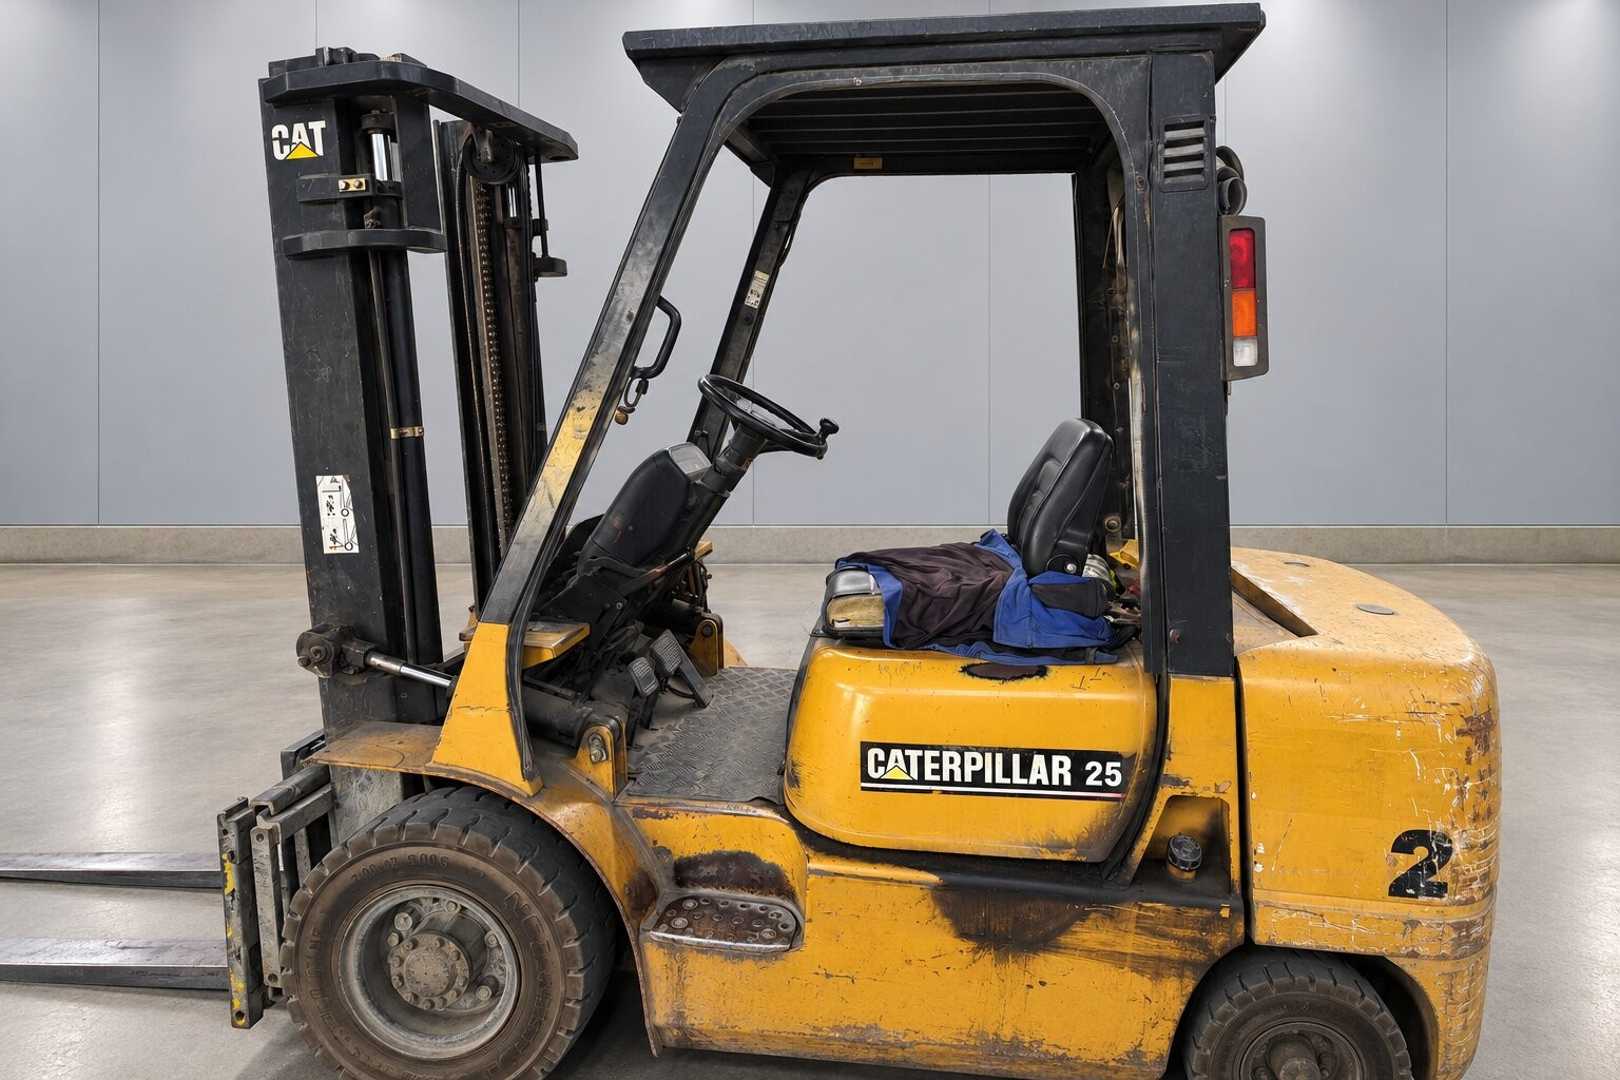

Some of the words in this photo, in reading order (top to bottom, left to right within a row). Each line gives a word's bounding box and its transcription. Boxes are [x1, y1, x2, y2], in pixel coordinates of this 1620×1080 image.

[271, 120, 326, 160] CAT
[867, 747, 1072, 786] CATERPILLAR
[1084, 761, 1122, 787] 25
[1388, 829, 1453, 899] 2
